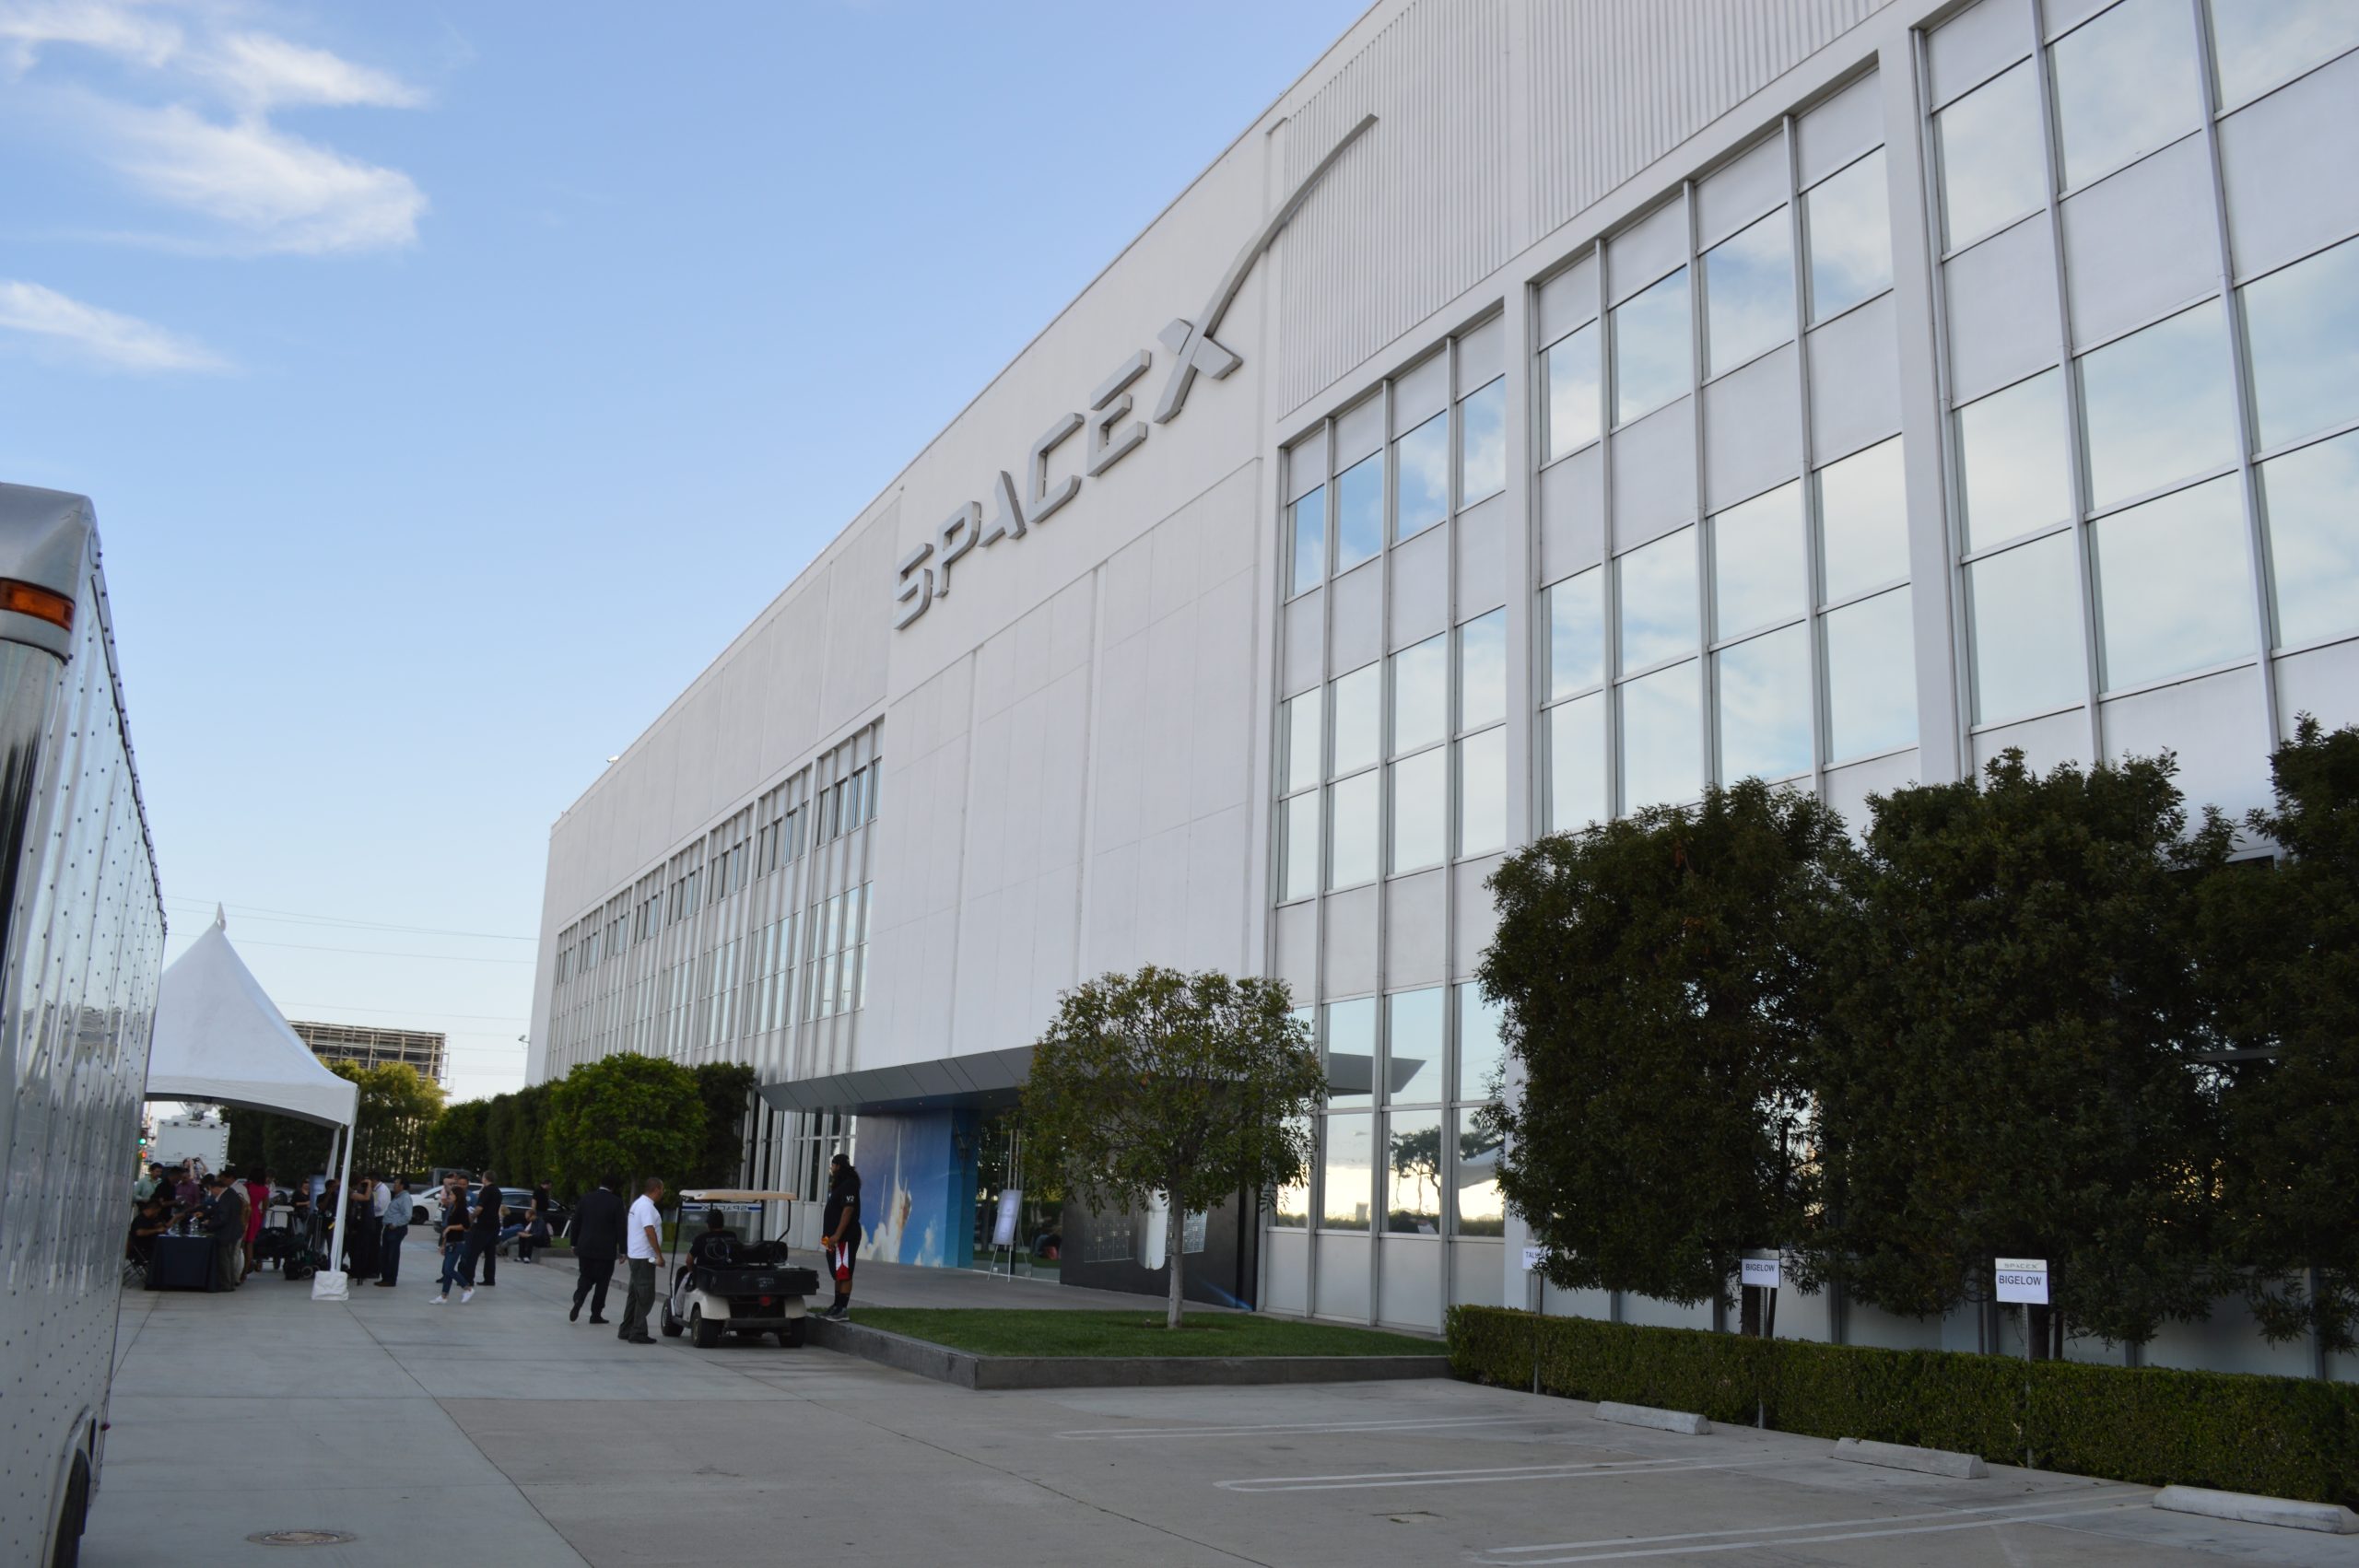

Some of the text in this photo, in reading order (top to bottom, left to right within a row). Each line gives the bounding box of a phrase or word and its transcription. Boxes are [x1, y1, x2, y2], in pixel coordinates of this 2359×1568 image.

[894, 113, 1379, 631] SPACEX
[1745, 1263, 1776, 1272] BIGELOW
[1999, 1275, 2042, 1286] BIGELOW
